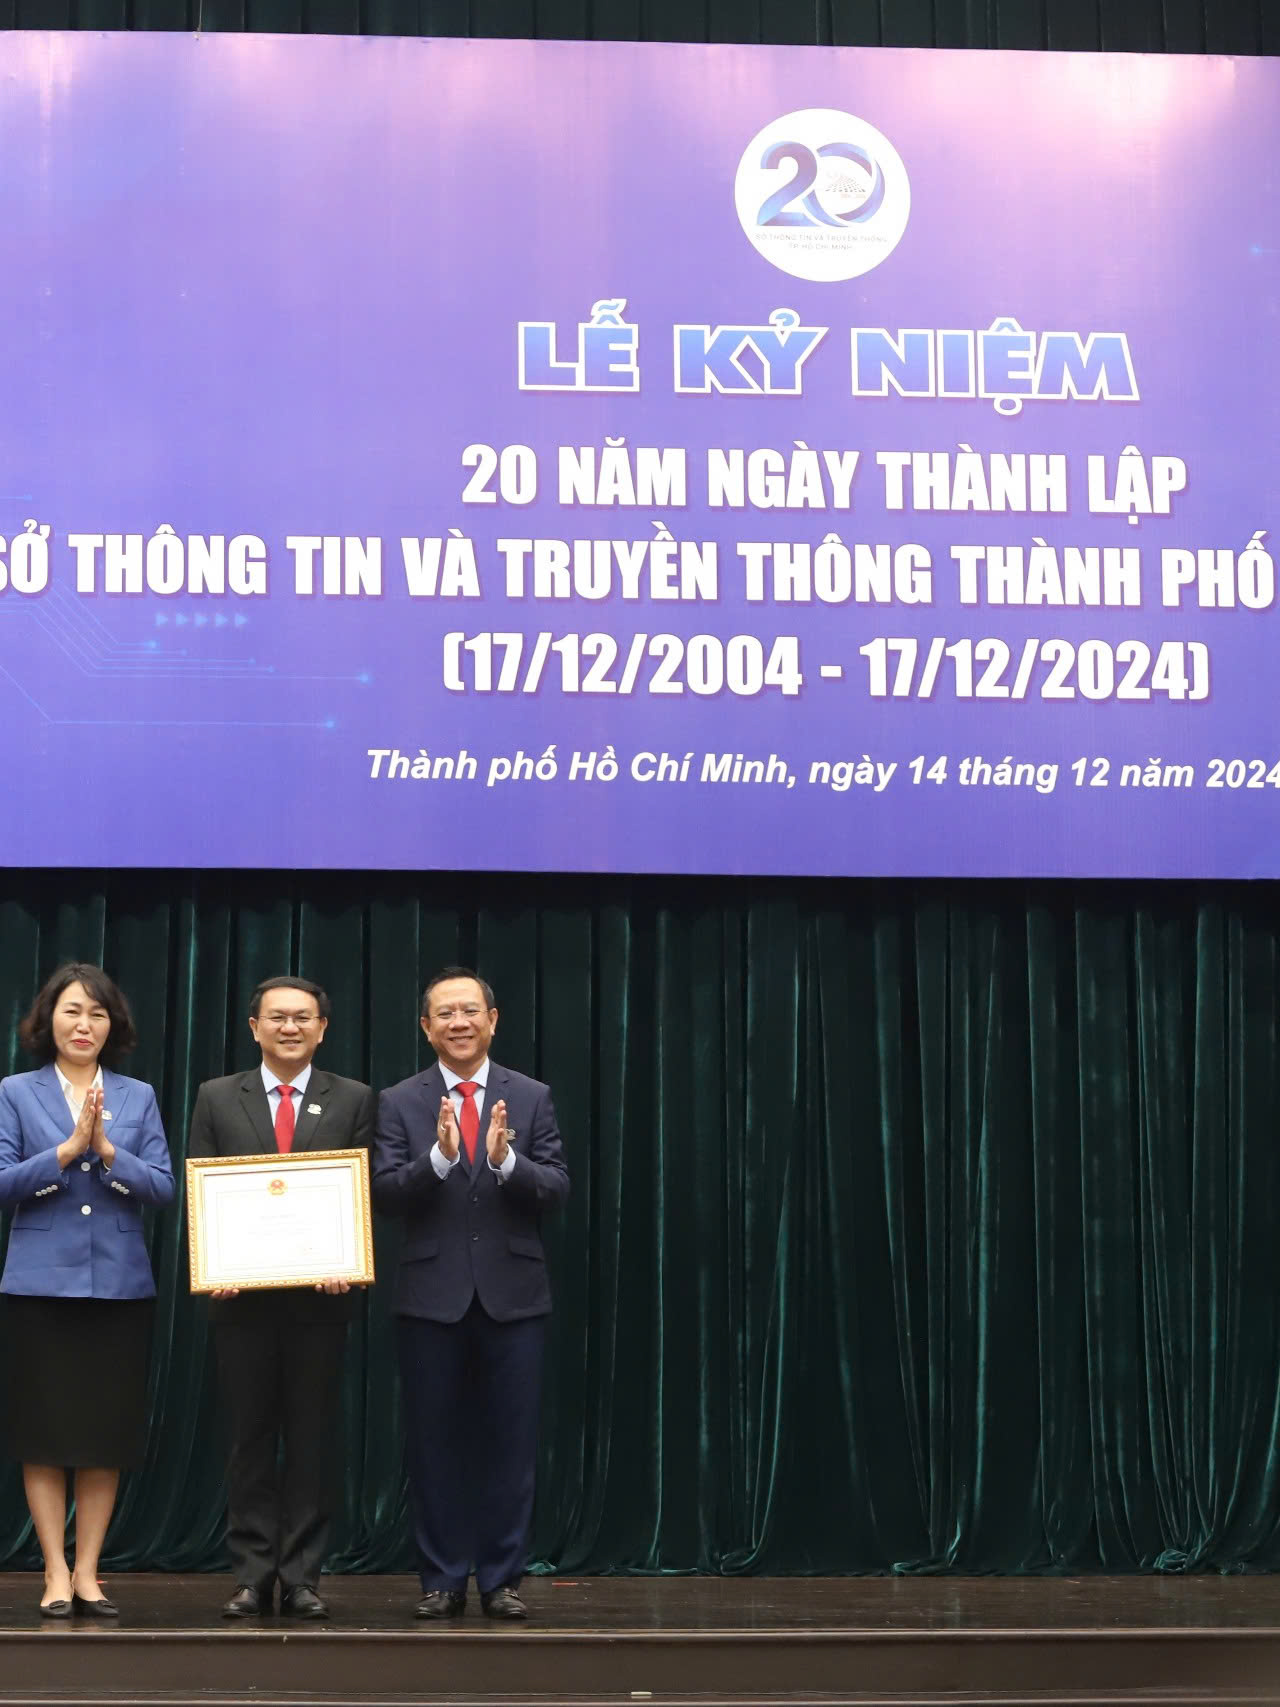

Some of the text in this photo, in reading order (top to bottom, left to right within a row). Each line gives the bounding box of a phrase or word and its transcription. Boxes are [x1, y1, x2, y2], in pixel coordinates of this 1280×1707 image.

[517, 298, 1141, 416] LỄ KỶ NIỆM
[461, 436, 1187, 525] 20 NĂM NGÀY THÀNH LẬP
[67, 523, 268, 596] THÔNG
[286, 535, 383, 597] TIN
[400, 528, 481, 597] VÀ
[496, 520, 718, 601] TRUYỀN
[736, 532, 933, 604] THÔNG
[950, 537, 1142, 606] THÀNH
[1161, 530, 1275, 609] PHỐ
[442, 631, 1210, 700] (17/12/2004 - 17/12/2024)
[367, 744, 1280, 794] Thành phố Hồ Chí Minh, ngày 14 tháng 12 năm 2024
